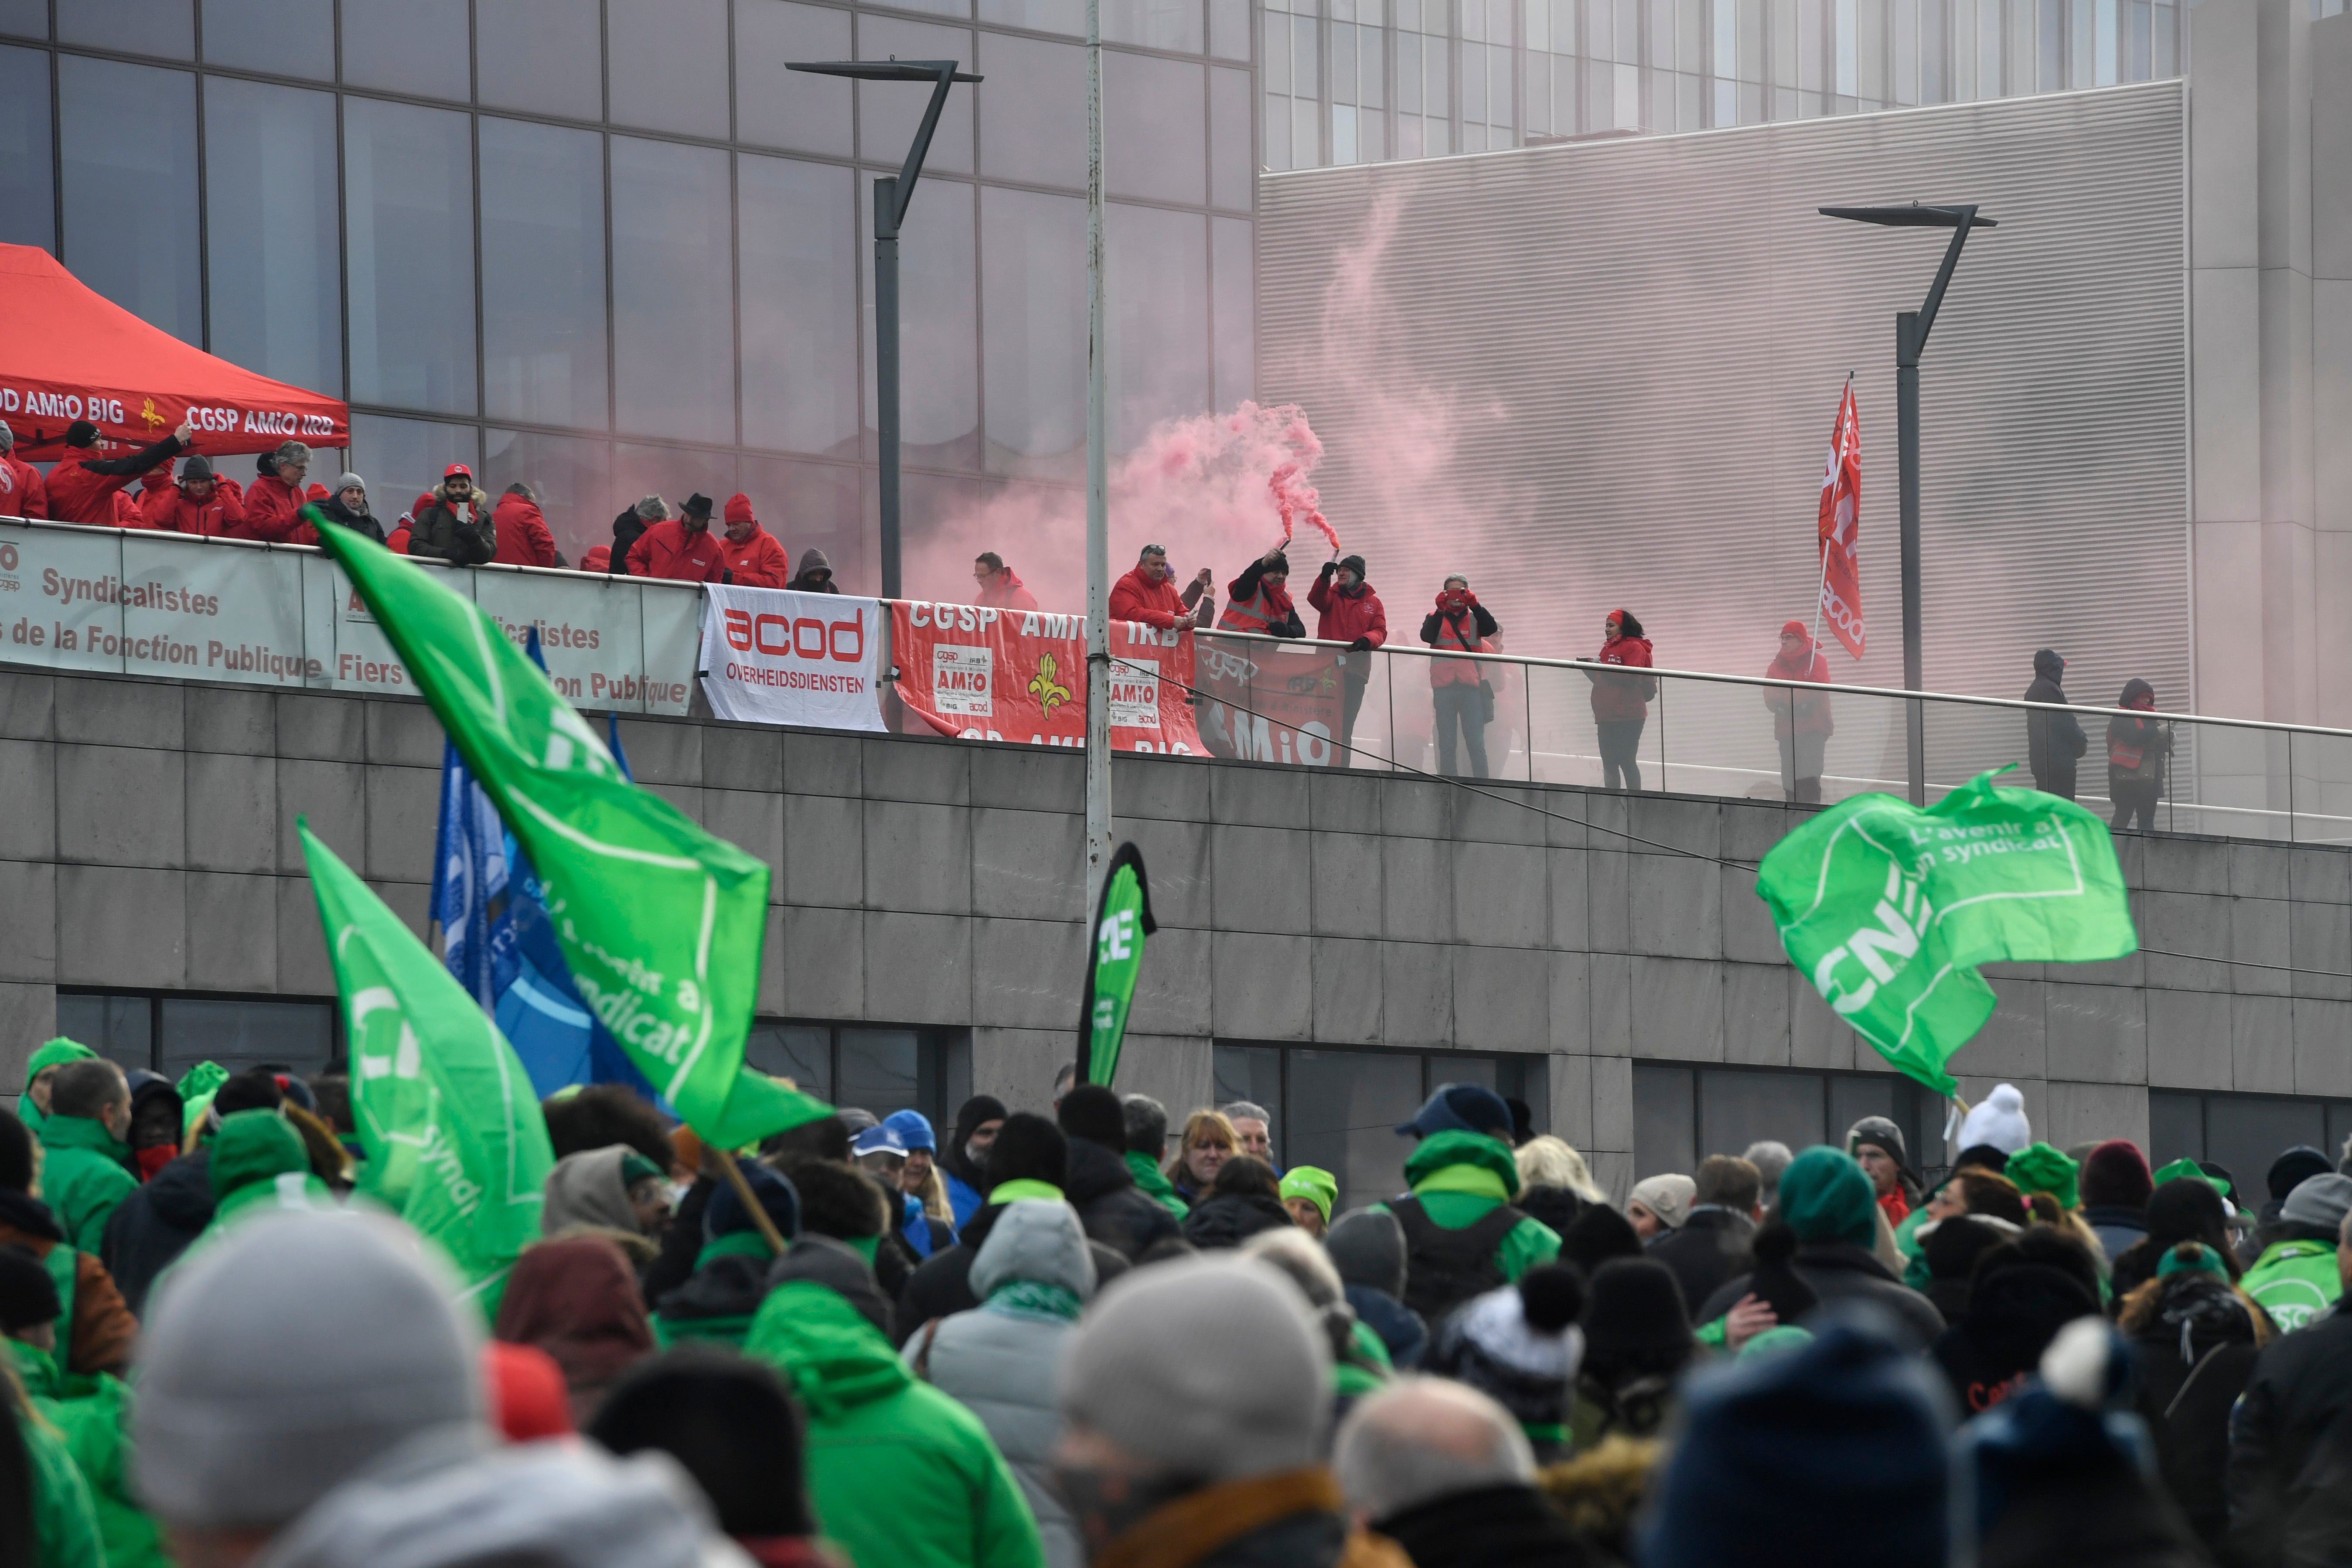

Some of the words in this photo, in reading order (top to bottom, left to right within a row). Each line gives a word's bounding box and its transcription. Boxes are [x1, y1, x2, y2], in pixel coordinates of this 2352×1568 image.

[88, 397, 123, 423] BIG
[187, 406, 239, 432] CGSP
[301, 414, 334, 435] IRB
[43, 568, 218, 616] Syndicalistes
[725, 608, 864, 663] acod
[909, 601, 998, 633] CGSP
[1020, 611, 1087, 641] AMI
[12, 617, 44, 646] de
[55, 621, 78, 650] la
[87, 625, 198, 665] Fonction
[208, 640, 322, 682] Publique
[937, 651, 958, 663] cgsp
[339, 654, 402, 684] Fiers
[726, 662, 864, 694] OVERHEIDSDIENSTEN
[1109, 664, 1129, 676] cgsp
[590, 672, 687, 707] Publique
[1813, 860, 1933, 1014] CNE
[573, 972, 691, 1064] ndicat
[418, 1124, 483, 1220] syndi
